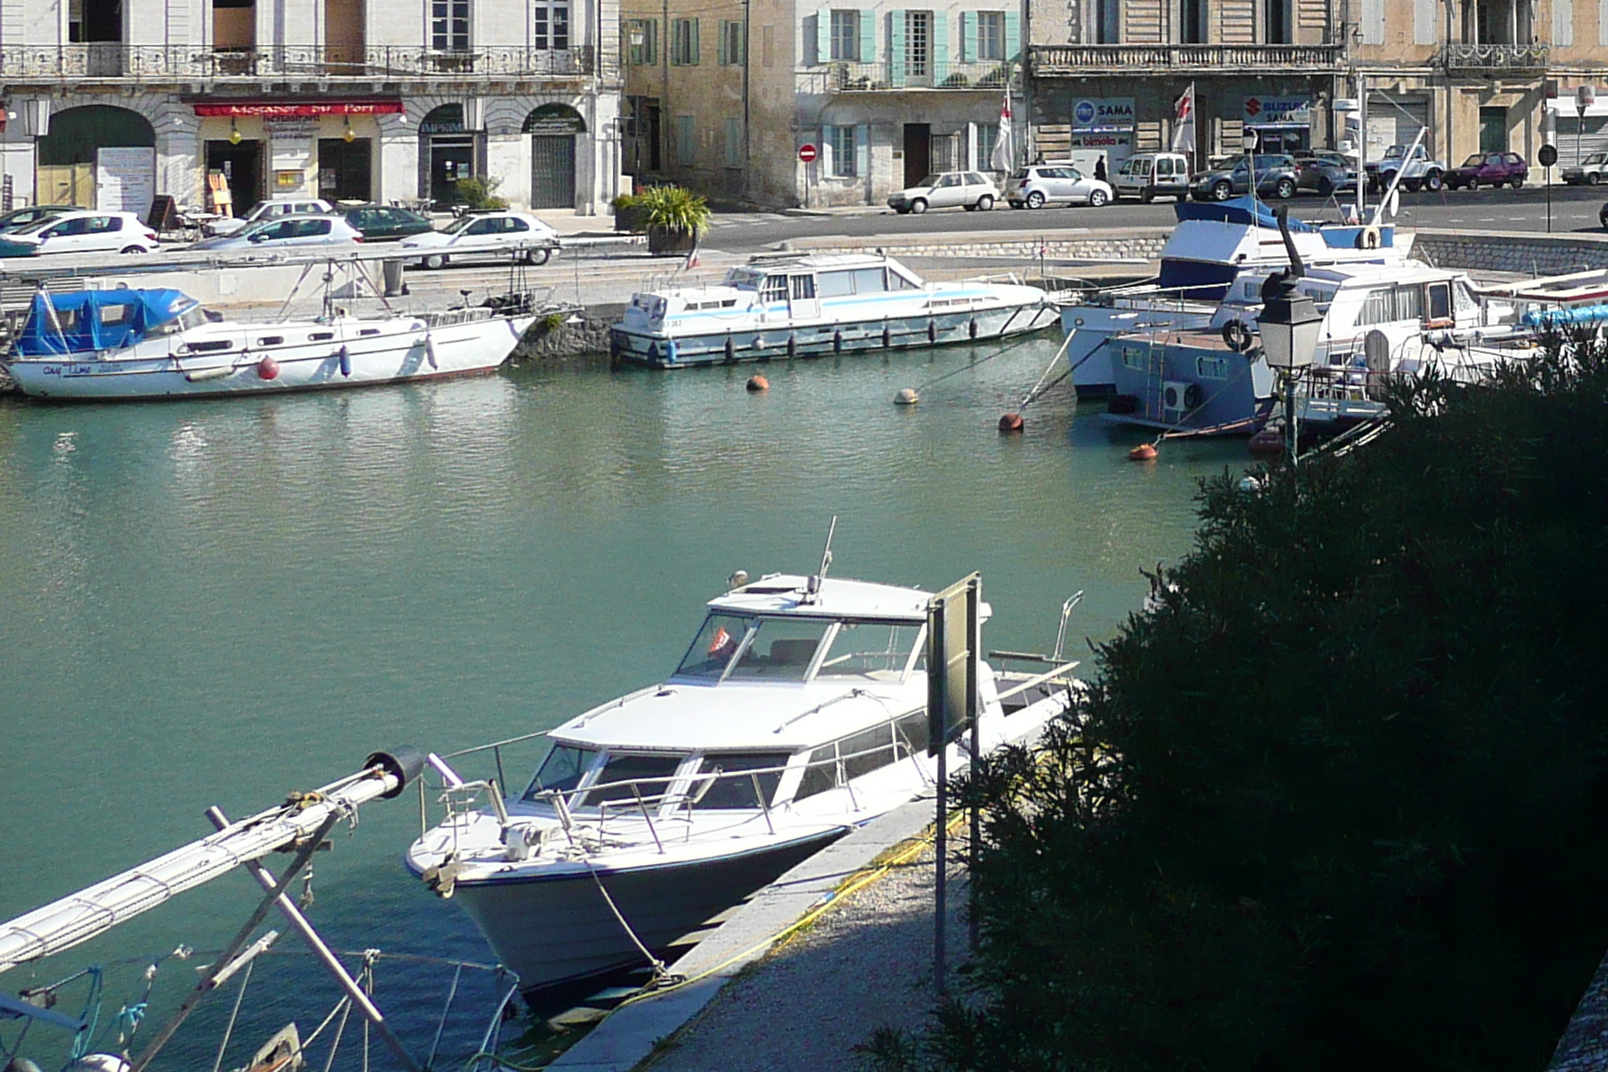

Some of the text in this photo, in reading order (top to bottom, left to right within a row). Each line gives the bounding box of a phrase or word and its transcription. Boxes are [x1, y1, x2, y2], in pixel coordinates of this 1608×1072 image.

[1099, 105, 1133, 116] SAMA
[1263, 101, 1309, 112] SUZUKI
[1266, 113, 1295, 122] SAMA
[421, 122, 465, 132] IMPRIM
